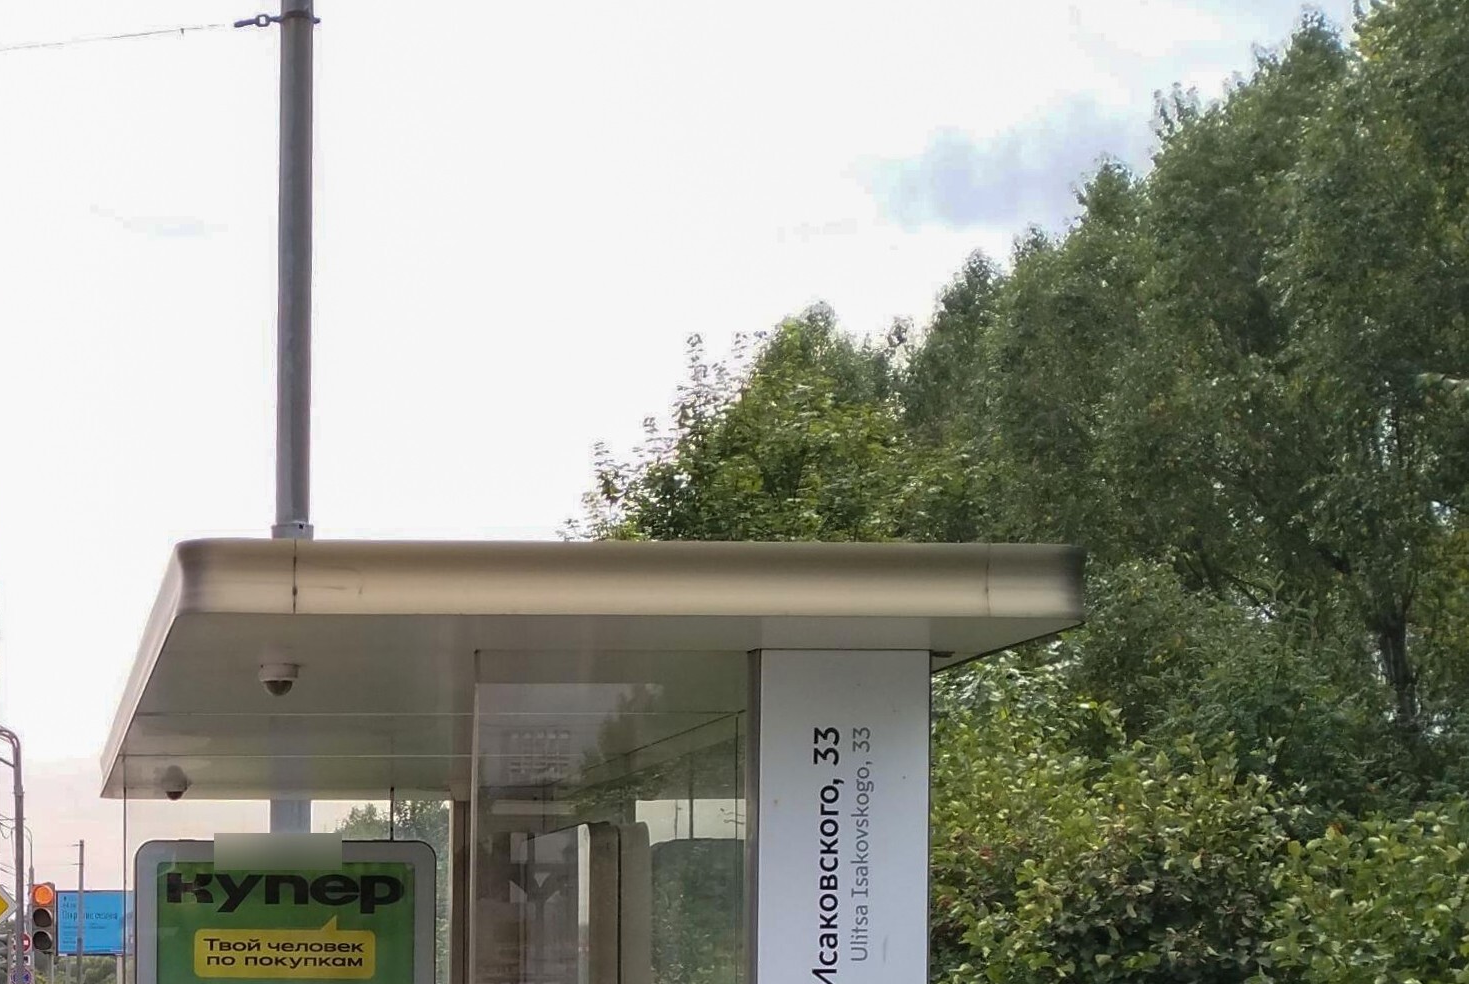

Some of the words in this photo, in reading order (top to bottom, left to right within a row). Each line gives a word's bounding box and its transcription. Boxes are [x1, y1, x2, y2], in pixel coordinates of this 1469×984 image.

[813, 727, 841, 766] 33
[852, 727, 871, 753] 33
[850, 761, 874, 898] Isakovskogo,
[203, 938, 261, 952] Твой
[267, 939, 364, 953] человек
[849, 905, 869, 962] Ulitsa
[206, 956, 236, 966] по
[244, 956, 364, 969] покупкам
